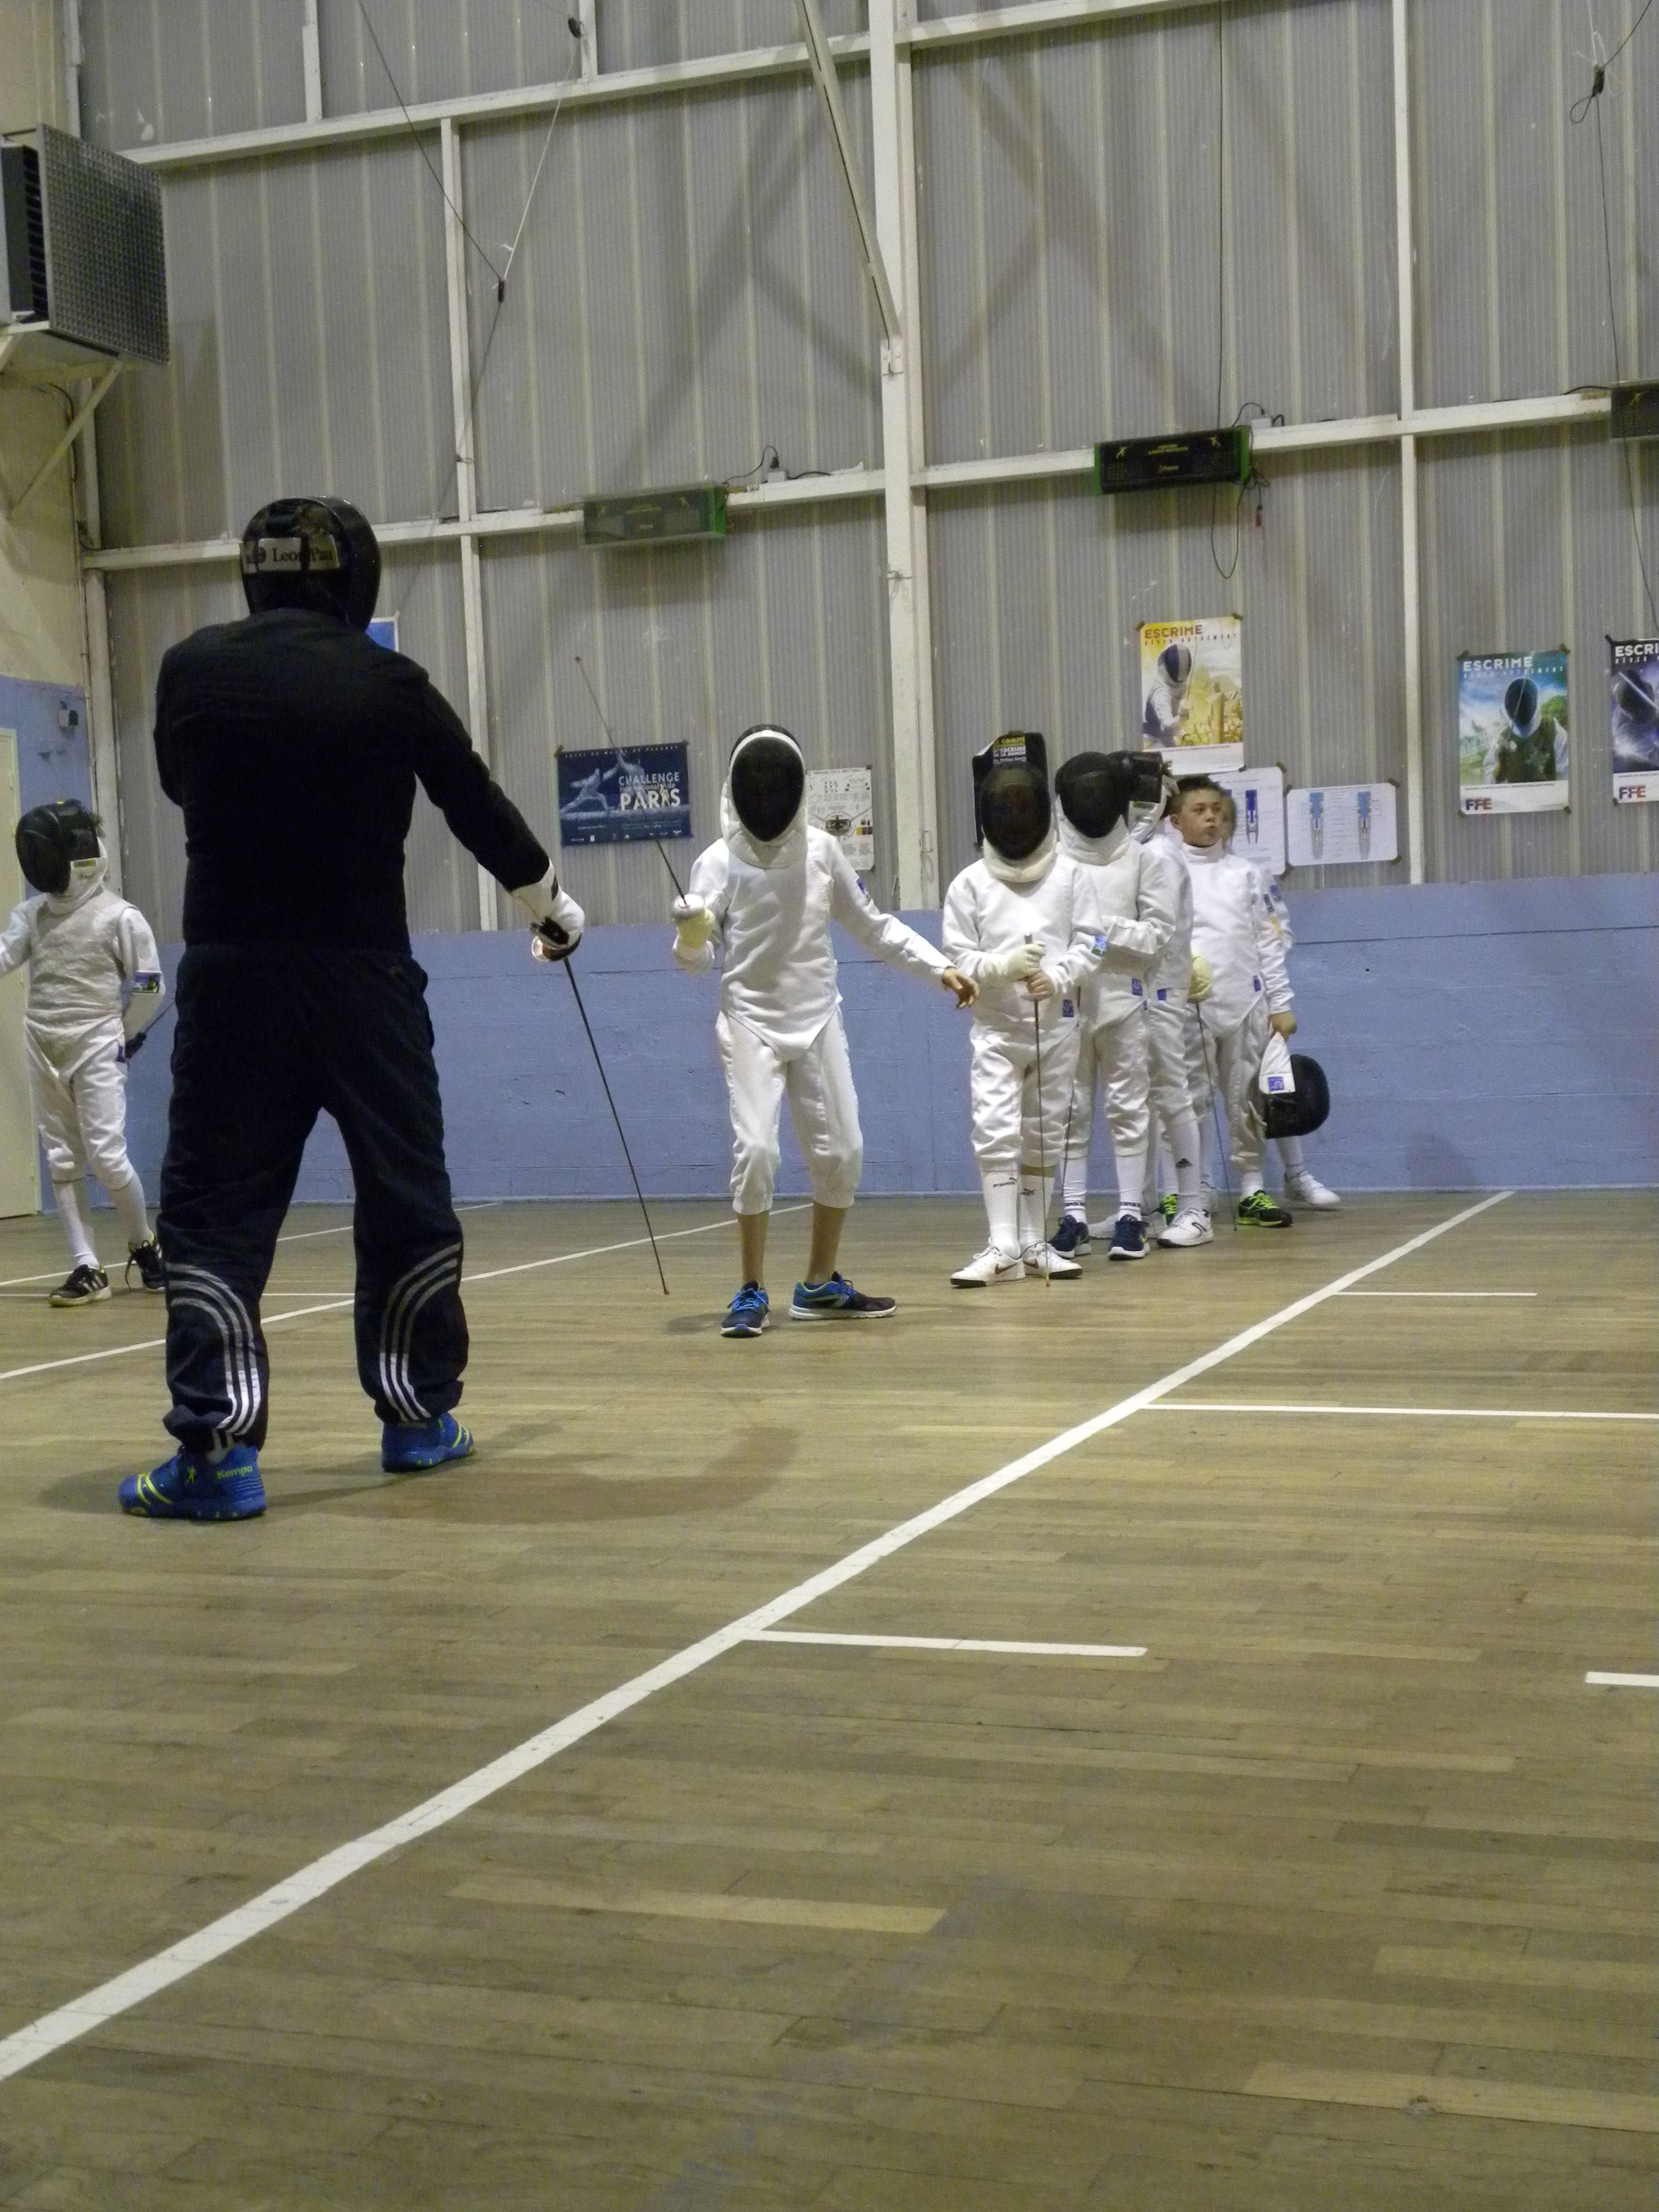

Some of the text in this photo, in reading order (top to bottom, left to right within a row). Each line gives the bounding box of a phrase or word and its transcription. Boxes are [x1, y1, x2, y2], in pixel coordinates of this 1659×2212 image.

[1144, 625, 1203, 639] ESCRIME
[1615, 643, 1659, 657] ESCRI
[1463, 656, 1533, 671] ESCRIME
[618, 772, 680, 786] CHALLENGE
[1619, 786, 1646, 799] FFE
[620, 789, 681, 811] PARIS
[1466, 799, 1493, 811] FFE
[216, 1466, 253, 1480] Kempa
